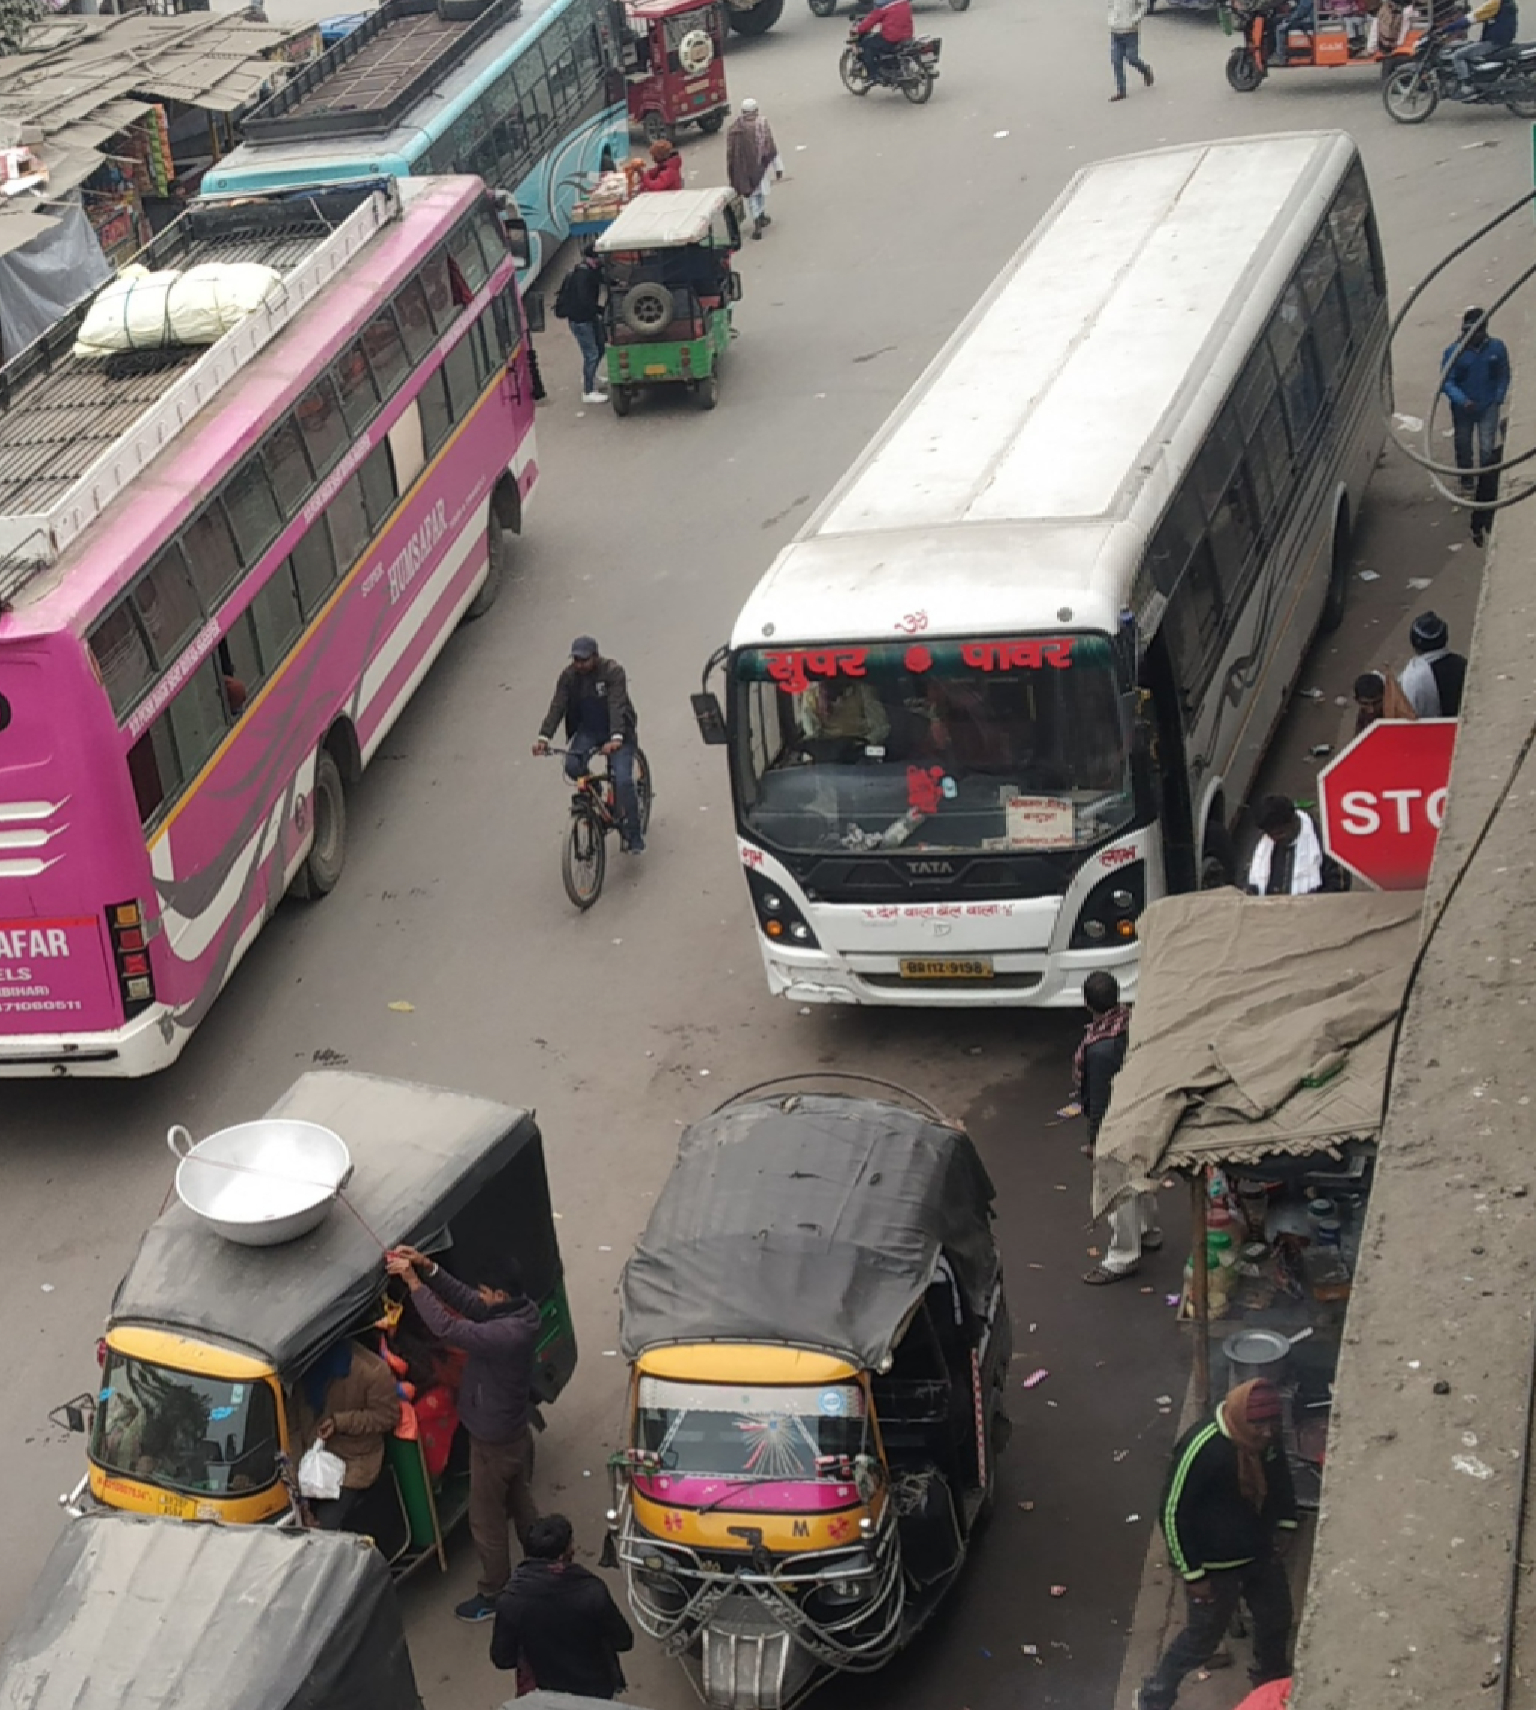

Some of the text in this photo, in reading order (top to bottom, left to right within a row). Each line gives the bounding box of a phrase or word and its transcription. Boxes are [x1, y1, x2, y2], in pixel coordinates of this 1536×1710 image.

[764, 637, 1075, 694] सुपर पावर
[906, 861, 954, 874] TATA
